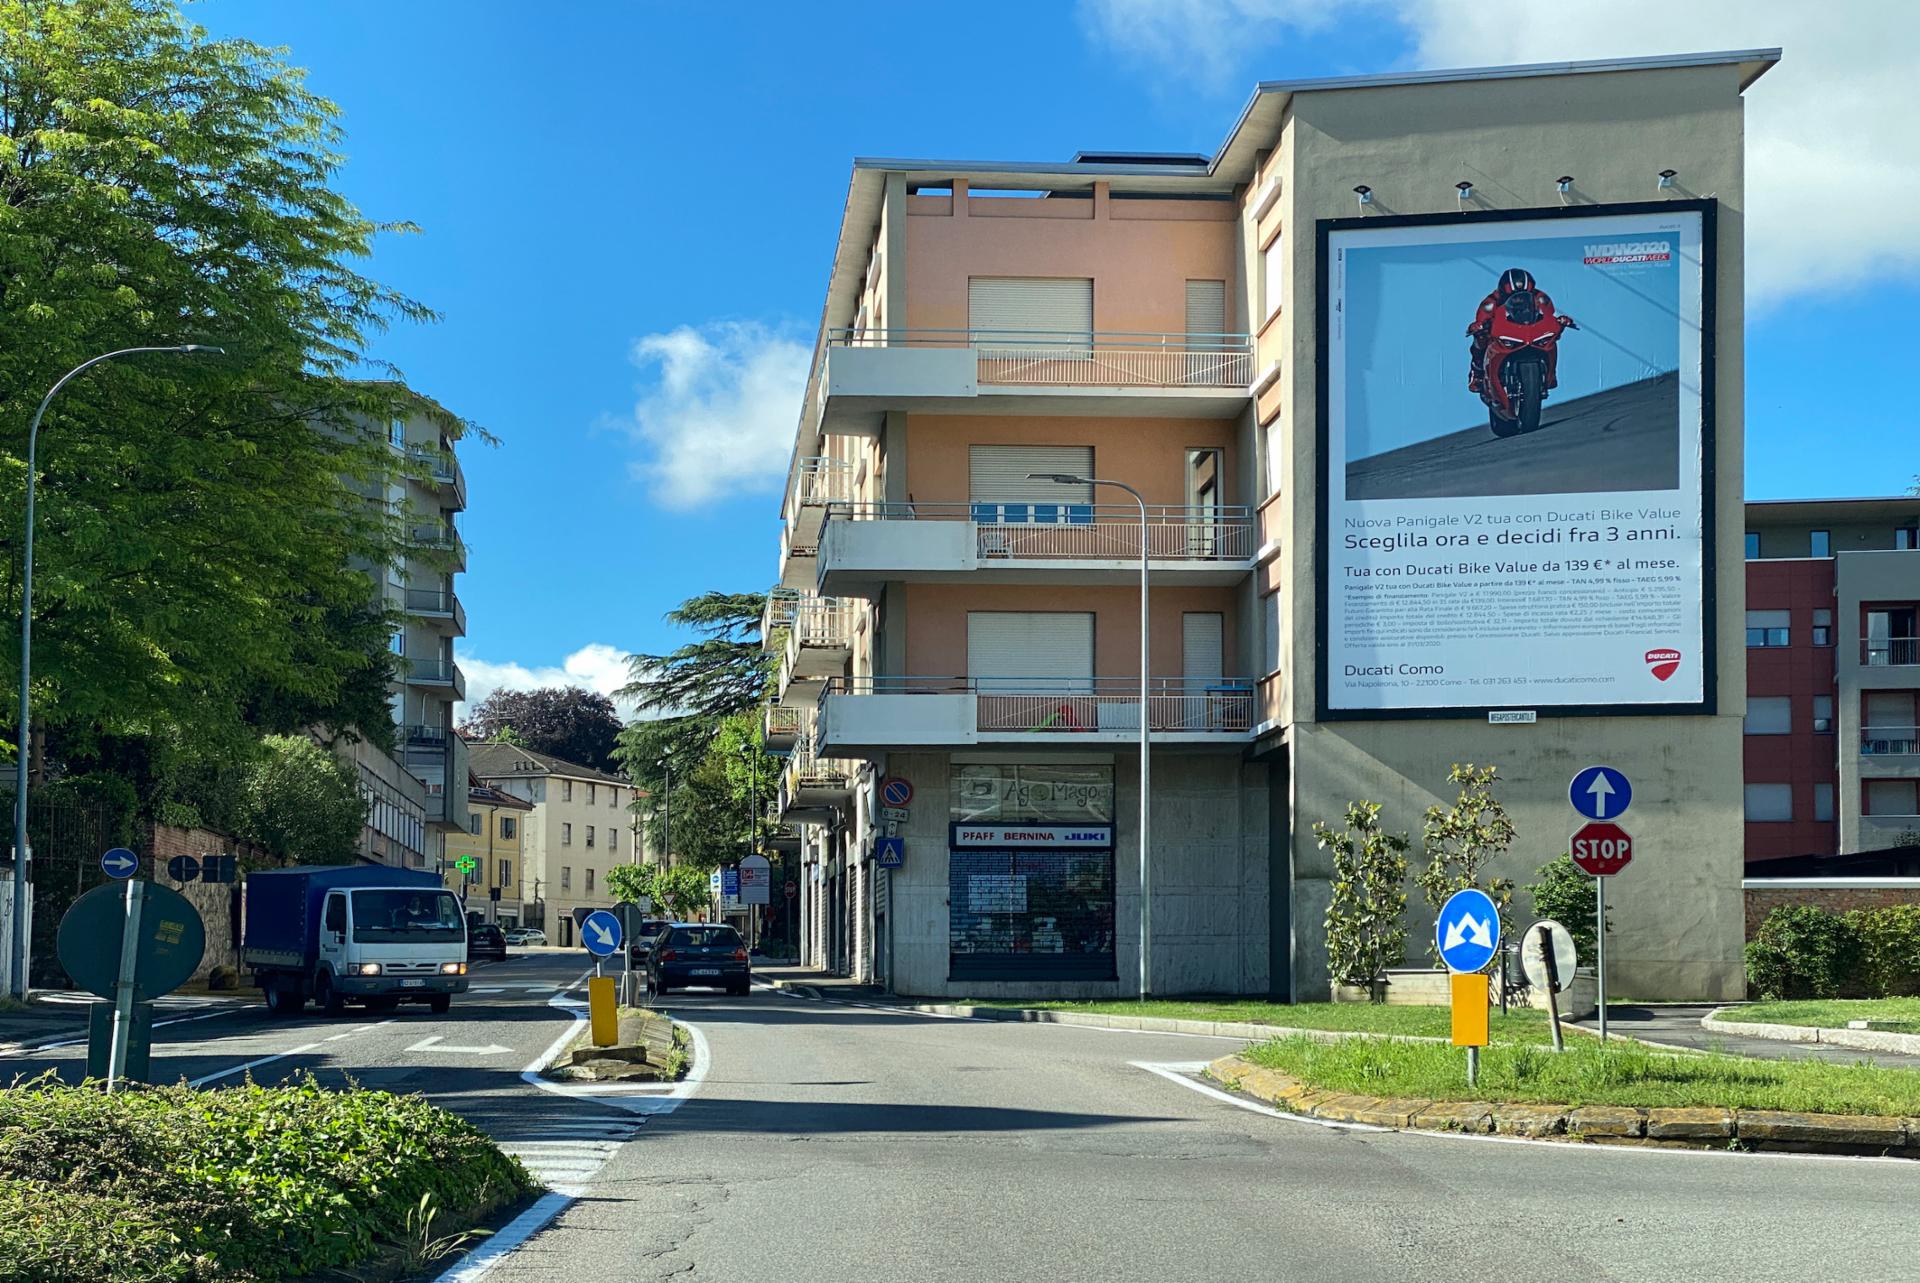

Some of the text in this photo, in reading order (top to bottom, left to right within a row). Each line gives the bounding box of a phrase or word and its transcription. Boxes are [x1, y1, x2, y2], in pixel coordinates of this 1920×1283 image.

[1584, 242, 1670, 257] WDW2020
[1345, 508, 1681, 529] Nuova Panigale V2 tua con Ducati Bike Value
[1345, 525, 1681, 553] Sceglila ora e decidi fra 3 anni.
[1344, 566, 1371, 577] Tua
[1375, 567, 1401, 576] con
[1406, 563, 1453, 575] Ducati
[1459, 562, 1491, 574] Bike
[1495, 561, 1538, 573] Value
[1542, 561, 1560, 572] da
[1564, 560, 1589, 571] 139
[1617, 559, 1630, 570] al
[1635, 560, 1680, 569] mese.
[1344, 584, 1373, 592] Panigale
[1479, 580, 1503, 588] partire
[1345, 663, 1444, 676] Ducati Como
[1344, 680, 1356, 688] Via
[1416, 679, 1439, 687] 22100
[1440, 678, 1462, 686] Como
[1483, 677, 1495, 685] 031
[962, 832, 1105, 840] PFAFF BERNINA JUKI
[1576, 839, 1629, 859] STOP
